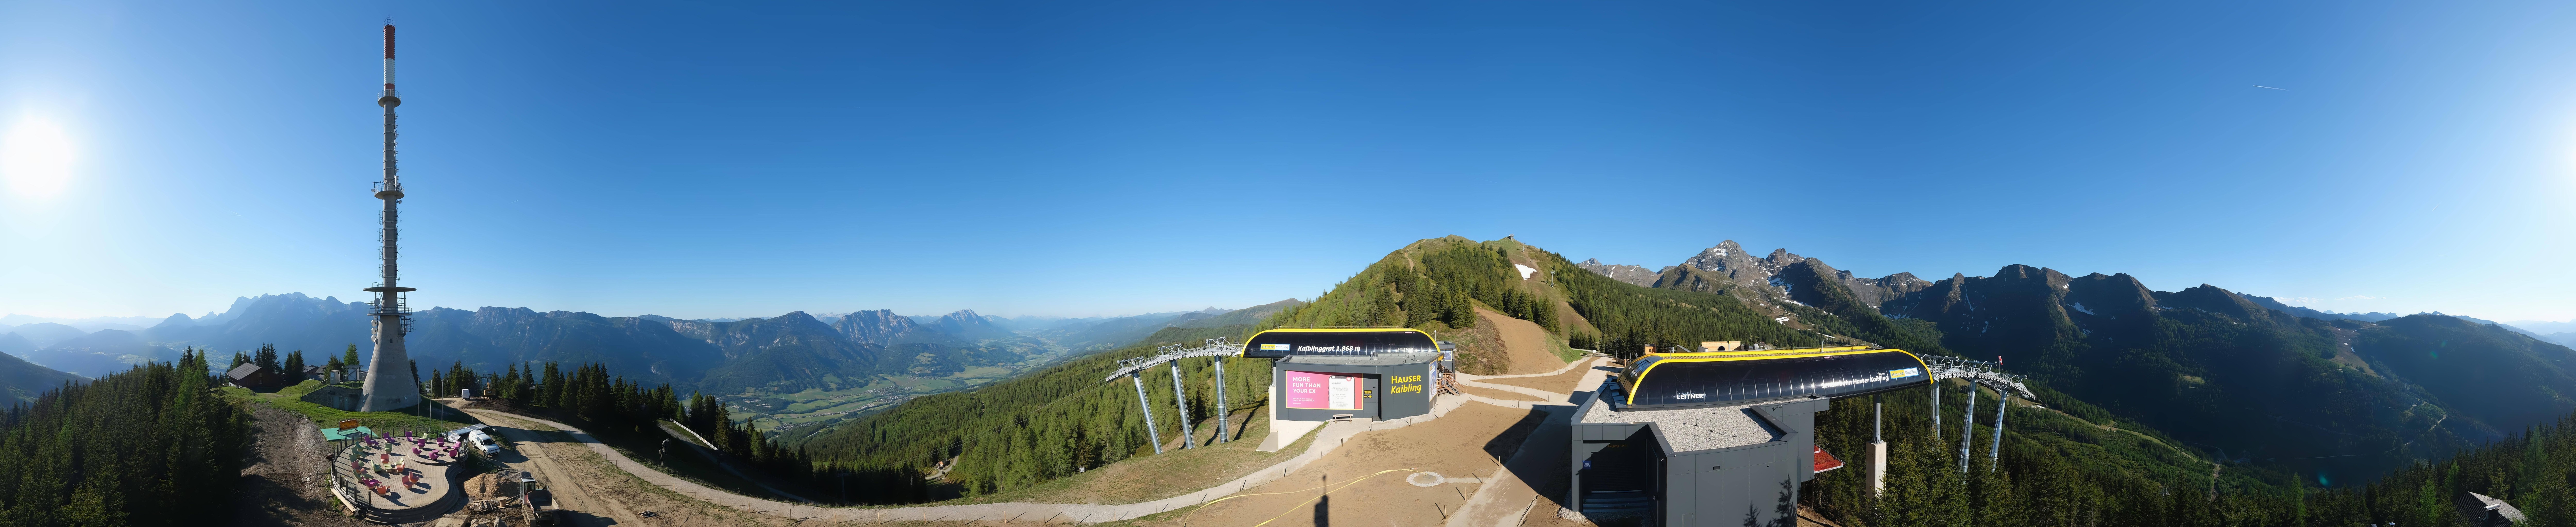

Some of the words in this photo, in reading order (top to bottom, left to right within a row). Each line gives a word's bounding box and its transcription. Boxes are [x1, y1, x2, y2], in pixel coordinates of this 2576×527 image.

[1391, 375, 1421, 384] HAUSER
[1822, 379, 1852, 388] Senderbahn
[1391, 384, 1421, 394] Kaibling
